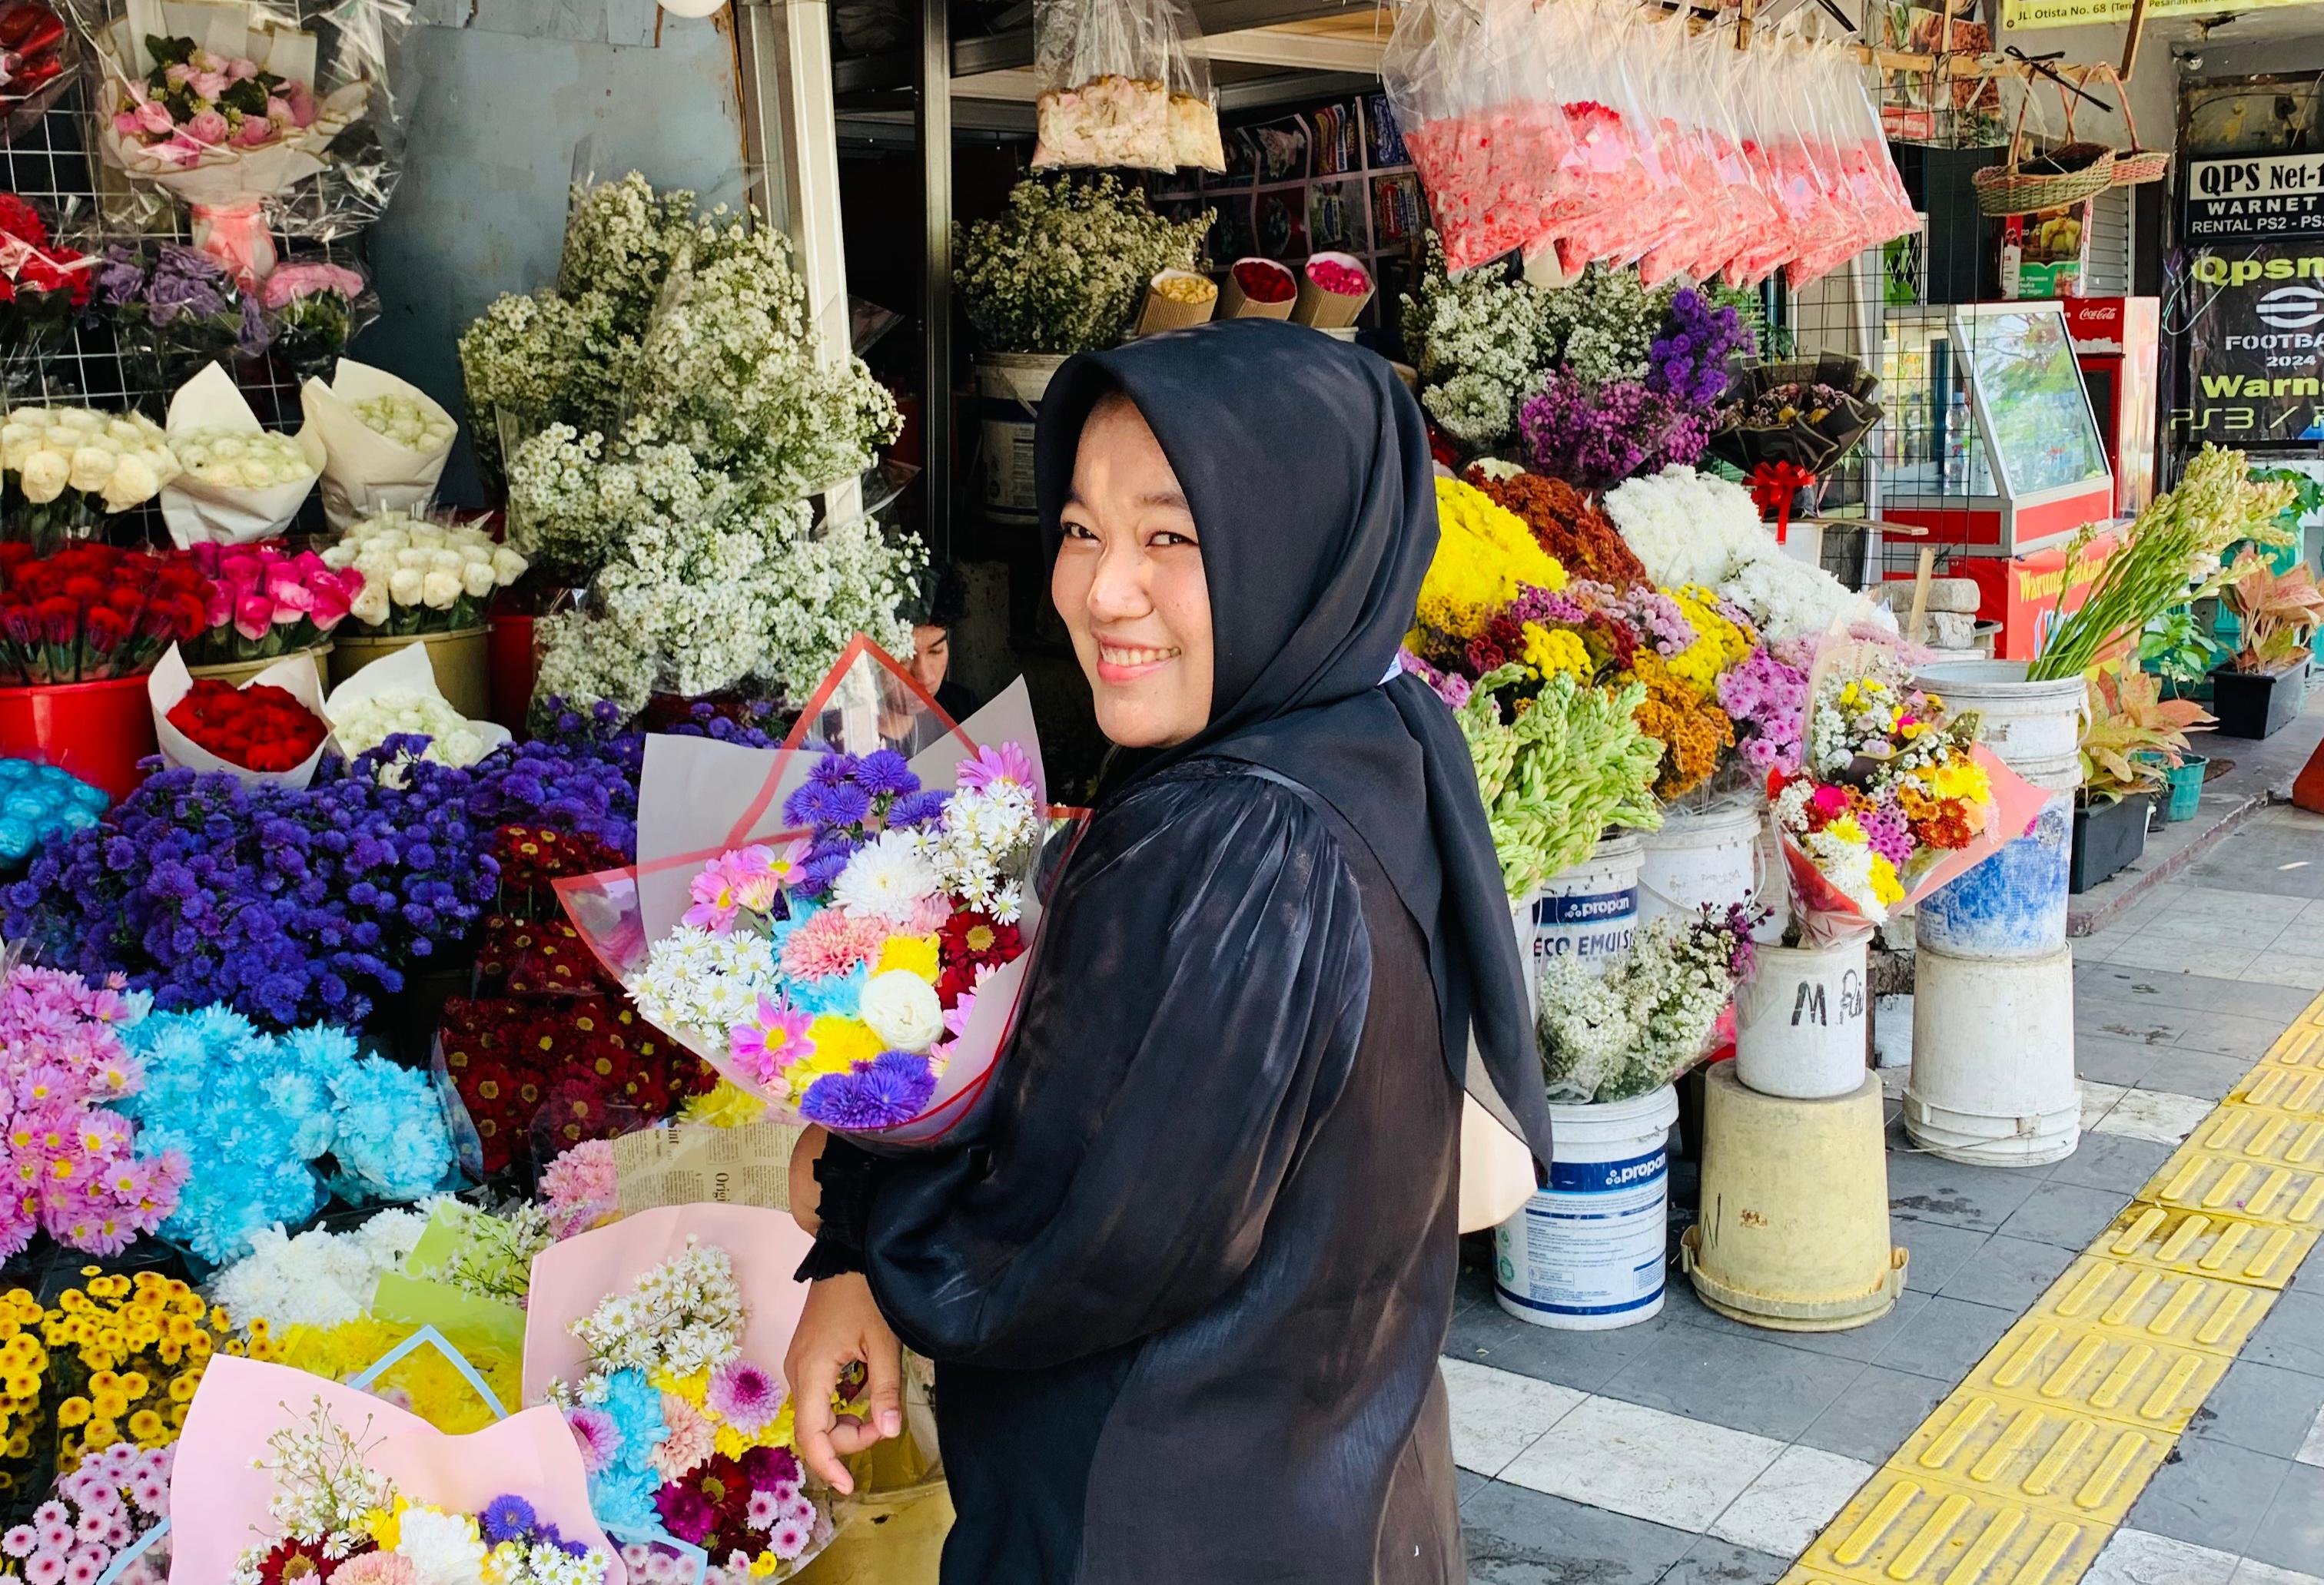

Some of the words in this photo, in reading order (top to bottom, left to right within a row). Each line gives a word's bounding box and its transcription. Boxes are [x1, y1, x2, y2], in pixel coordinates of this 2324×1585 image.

[2018, 11, 2031, 21] JL.
[2035, 8, 2067, 19] Otista
[2070, 6, 2090, 16] No.
[2093, 5, 2107, 13] 68
[2111, 2, 2135, 13] (Teri
[2200, 162, 2260, 197] QPS
[2207, 196, 2318, 216] WARNET
[2192, 219, 2253, 234] RENTAL
[2257, 217, 2287, 231] PS2
[2266, 355, 2317, 367] 2024
[2200, 374, 2324, 399] Warn
[2170, 407, 2255, 430] PS3
[1582, 897, 1629, 917] propan
[1533, 937, 1570, 957] ECO
[1621, 1152, 1666, 1182] propan
[712, 1172, 731, 1202] Origi
